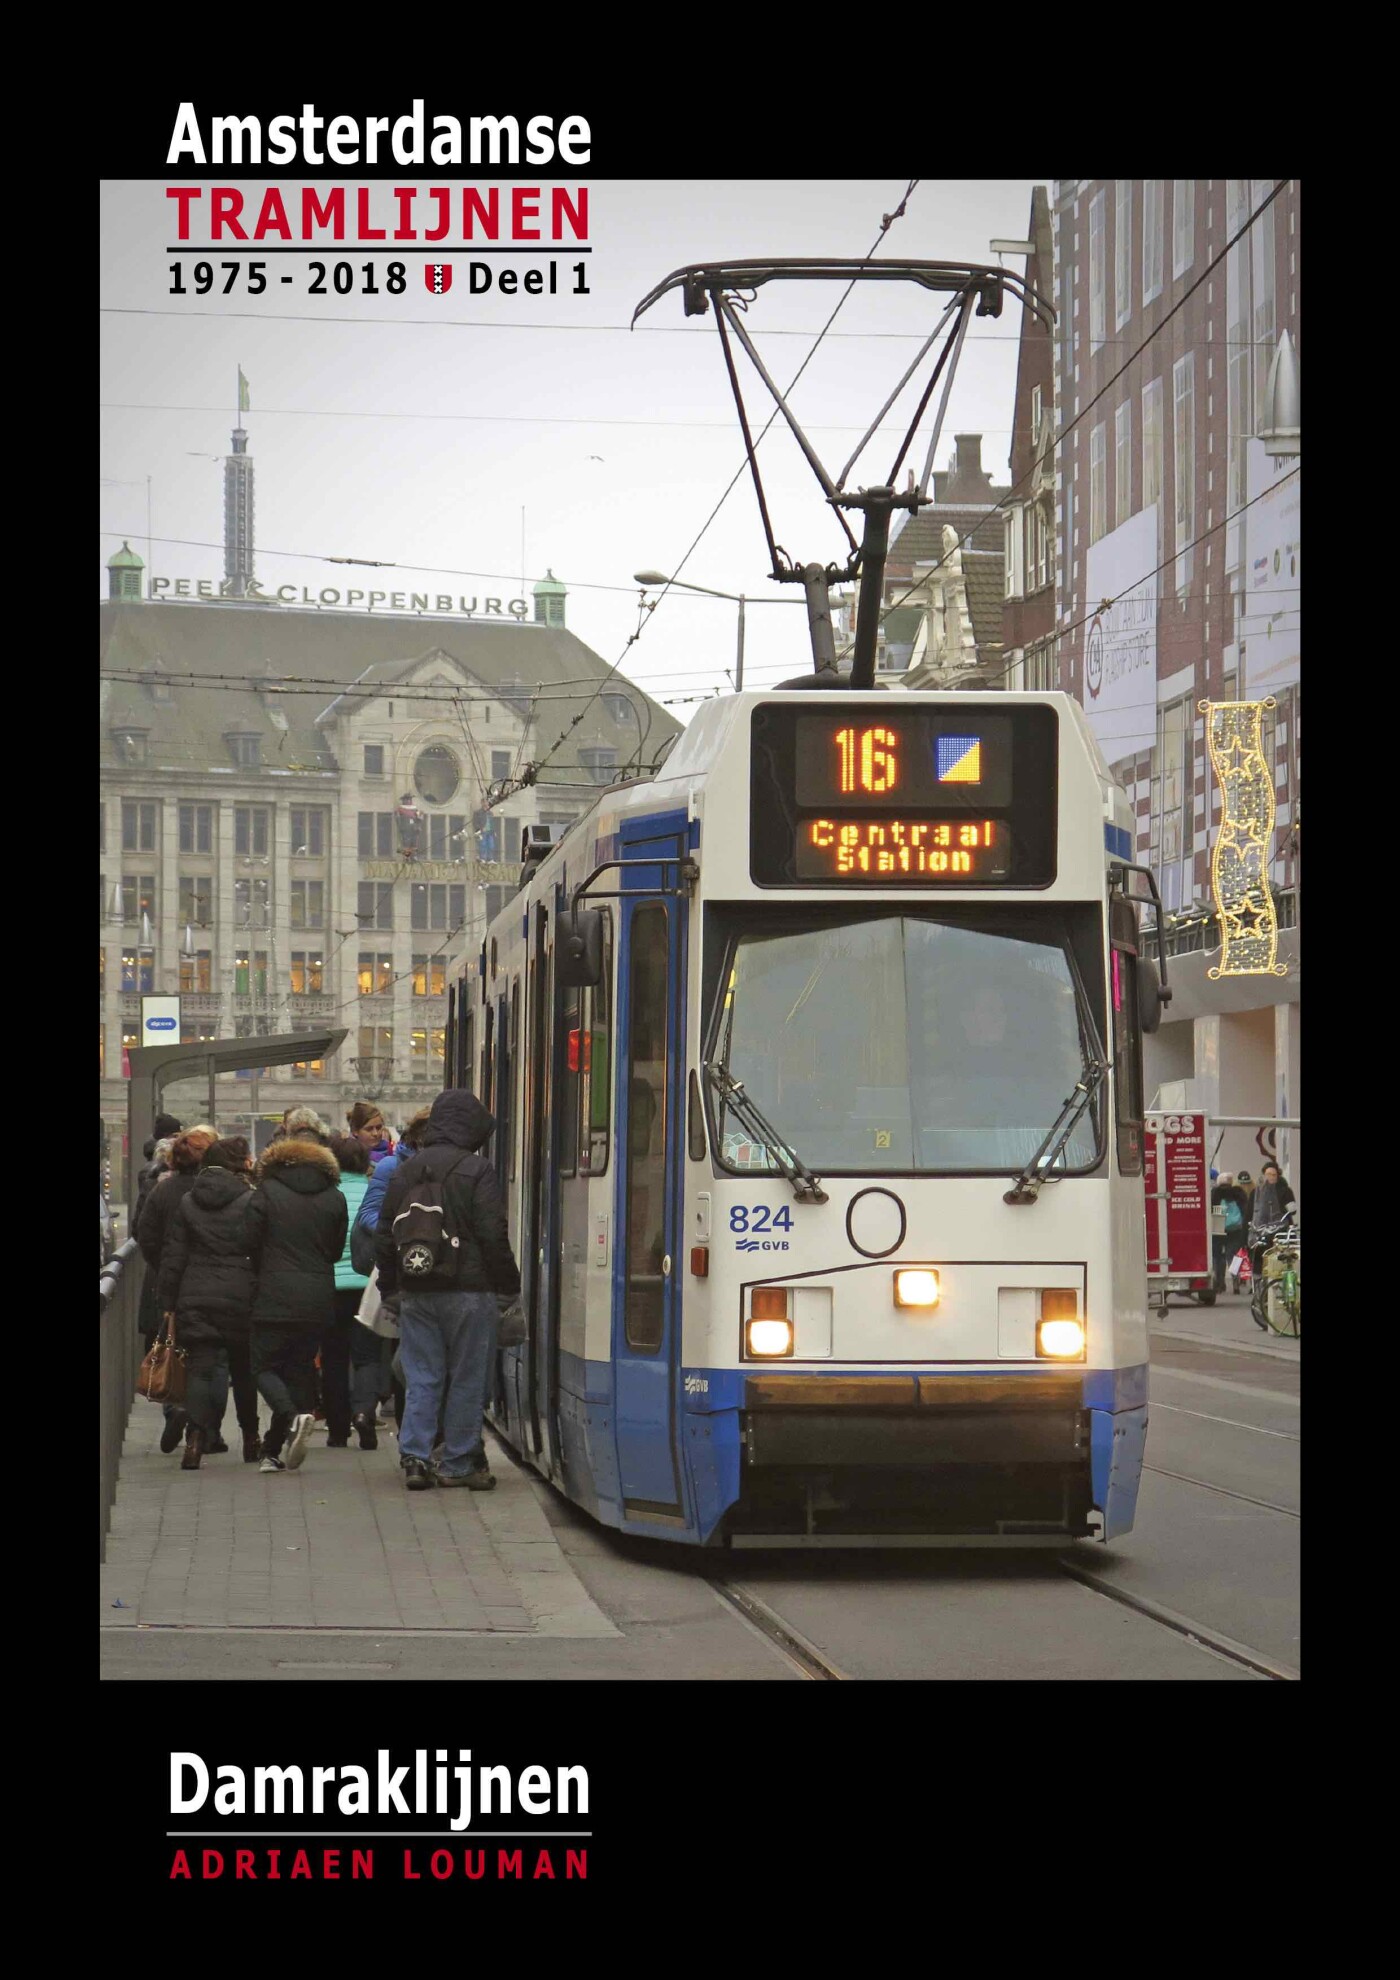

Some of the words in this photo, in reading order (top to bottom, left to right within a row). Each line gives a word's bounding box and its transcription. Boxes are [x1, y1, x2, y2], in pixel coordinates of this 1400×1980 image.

[152, 576, 233, 597] PEEK
[277, 584, 529, 615] CLOPPENBURG
[836, 729, 895, 791] 16
[812, 820, 992, 846] Centraal
[837, 846, 970, 872] Station
[878, 1134, 887, 1147] 2
[1176, 1136, 1202, 1144] MORE
[729, 1205, 794, 1233] 824
[761, 1241, 789, 1251] GVB
